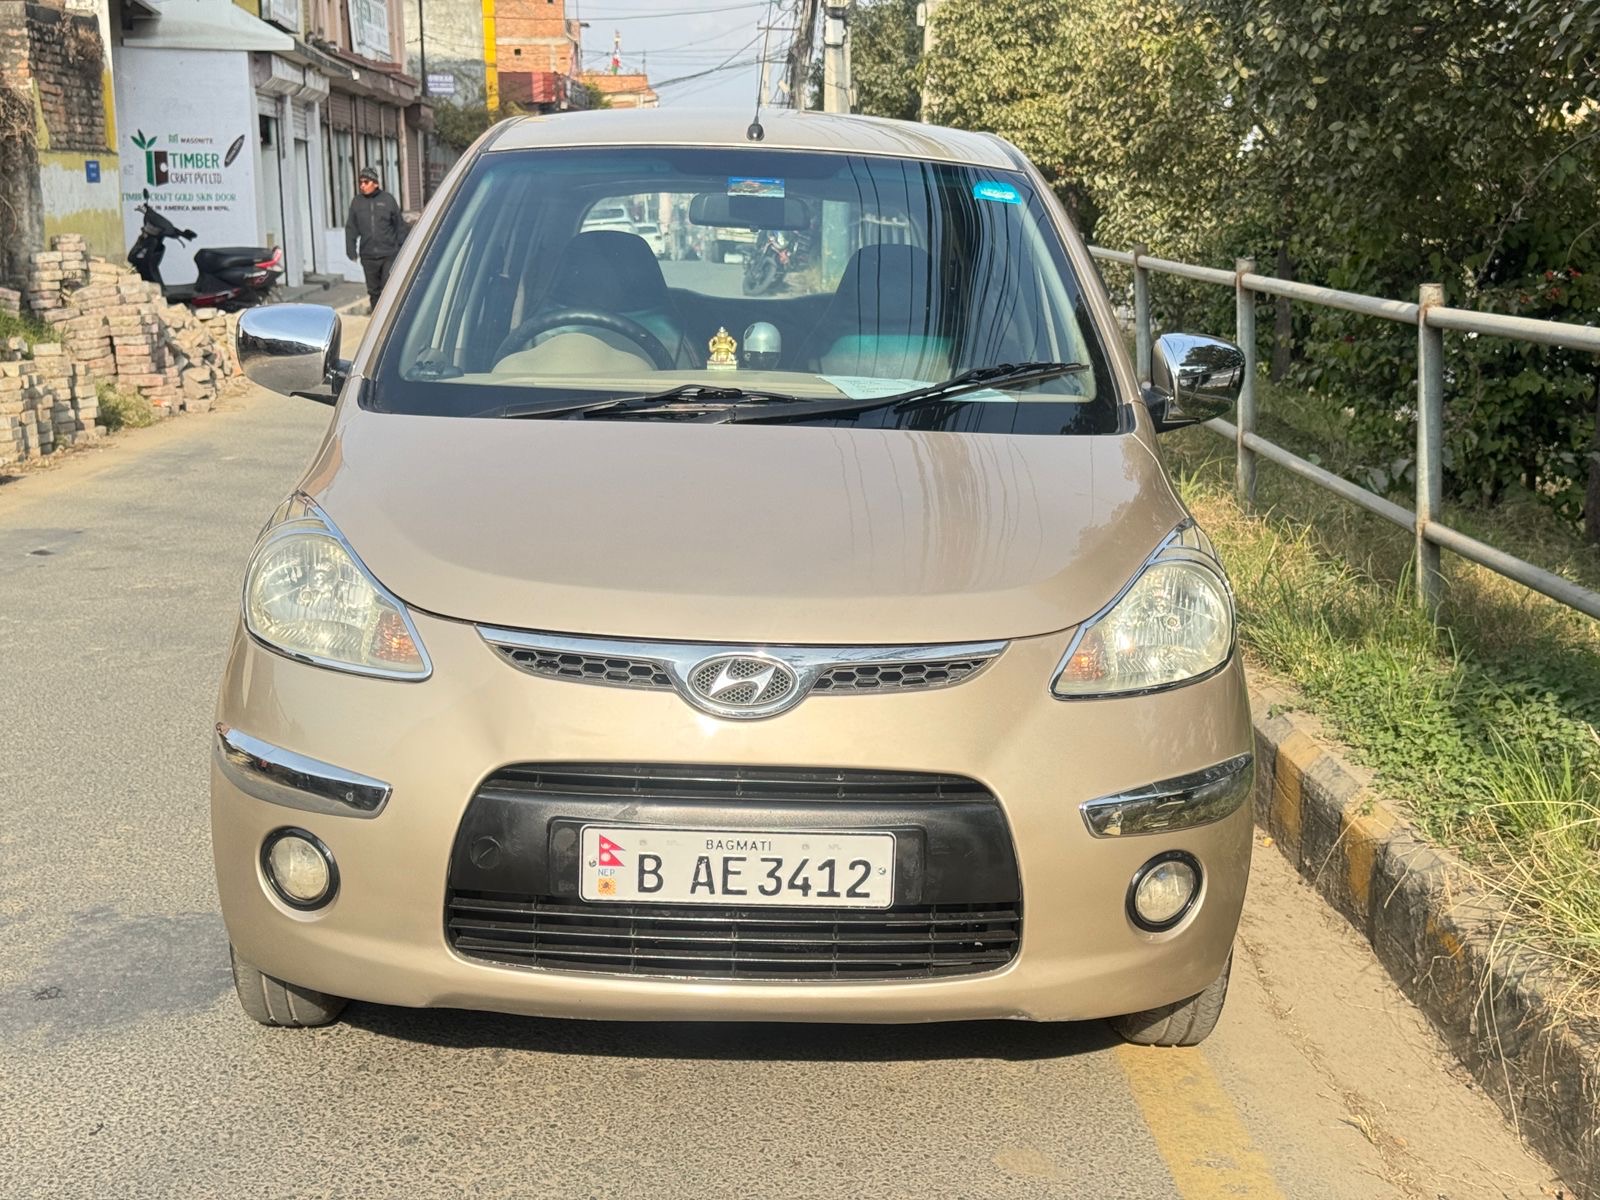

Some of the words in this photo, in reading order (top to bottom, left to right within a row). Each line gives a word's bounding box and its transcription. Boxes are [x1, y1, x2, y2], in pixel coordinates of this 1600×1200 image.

[169, 152, 220, 169] TIMBER
[170, 172, 193, 184] CRAFT
[175, 192, 194, 201] GOLD
[706, 839, 772, 852] BAGMATI
[597, 868, 616, 877] NEP
[637, 853, 664, 893] B
